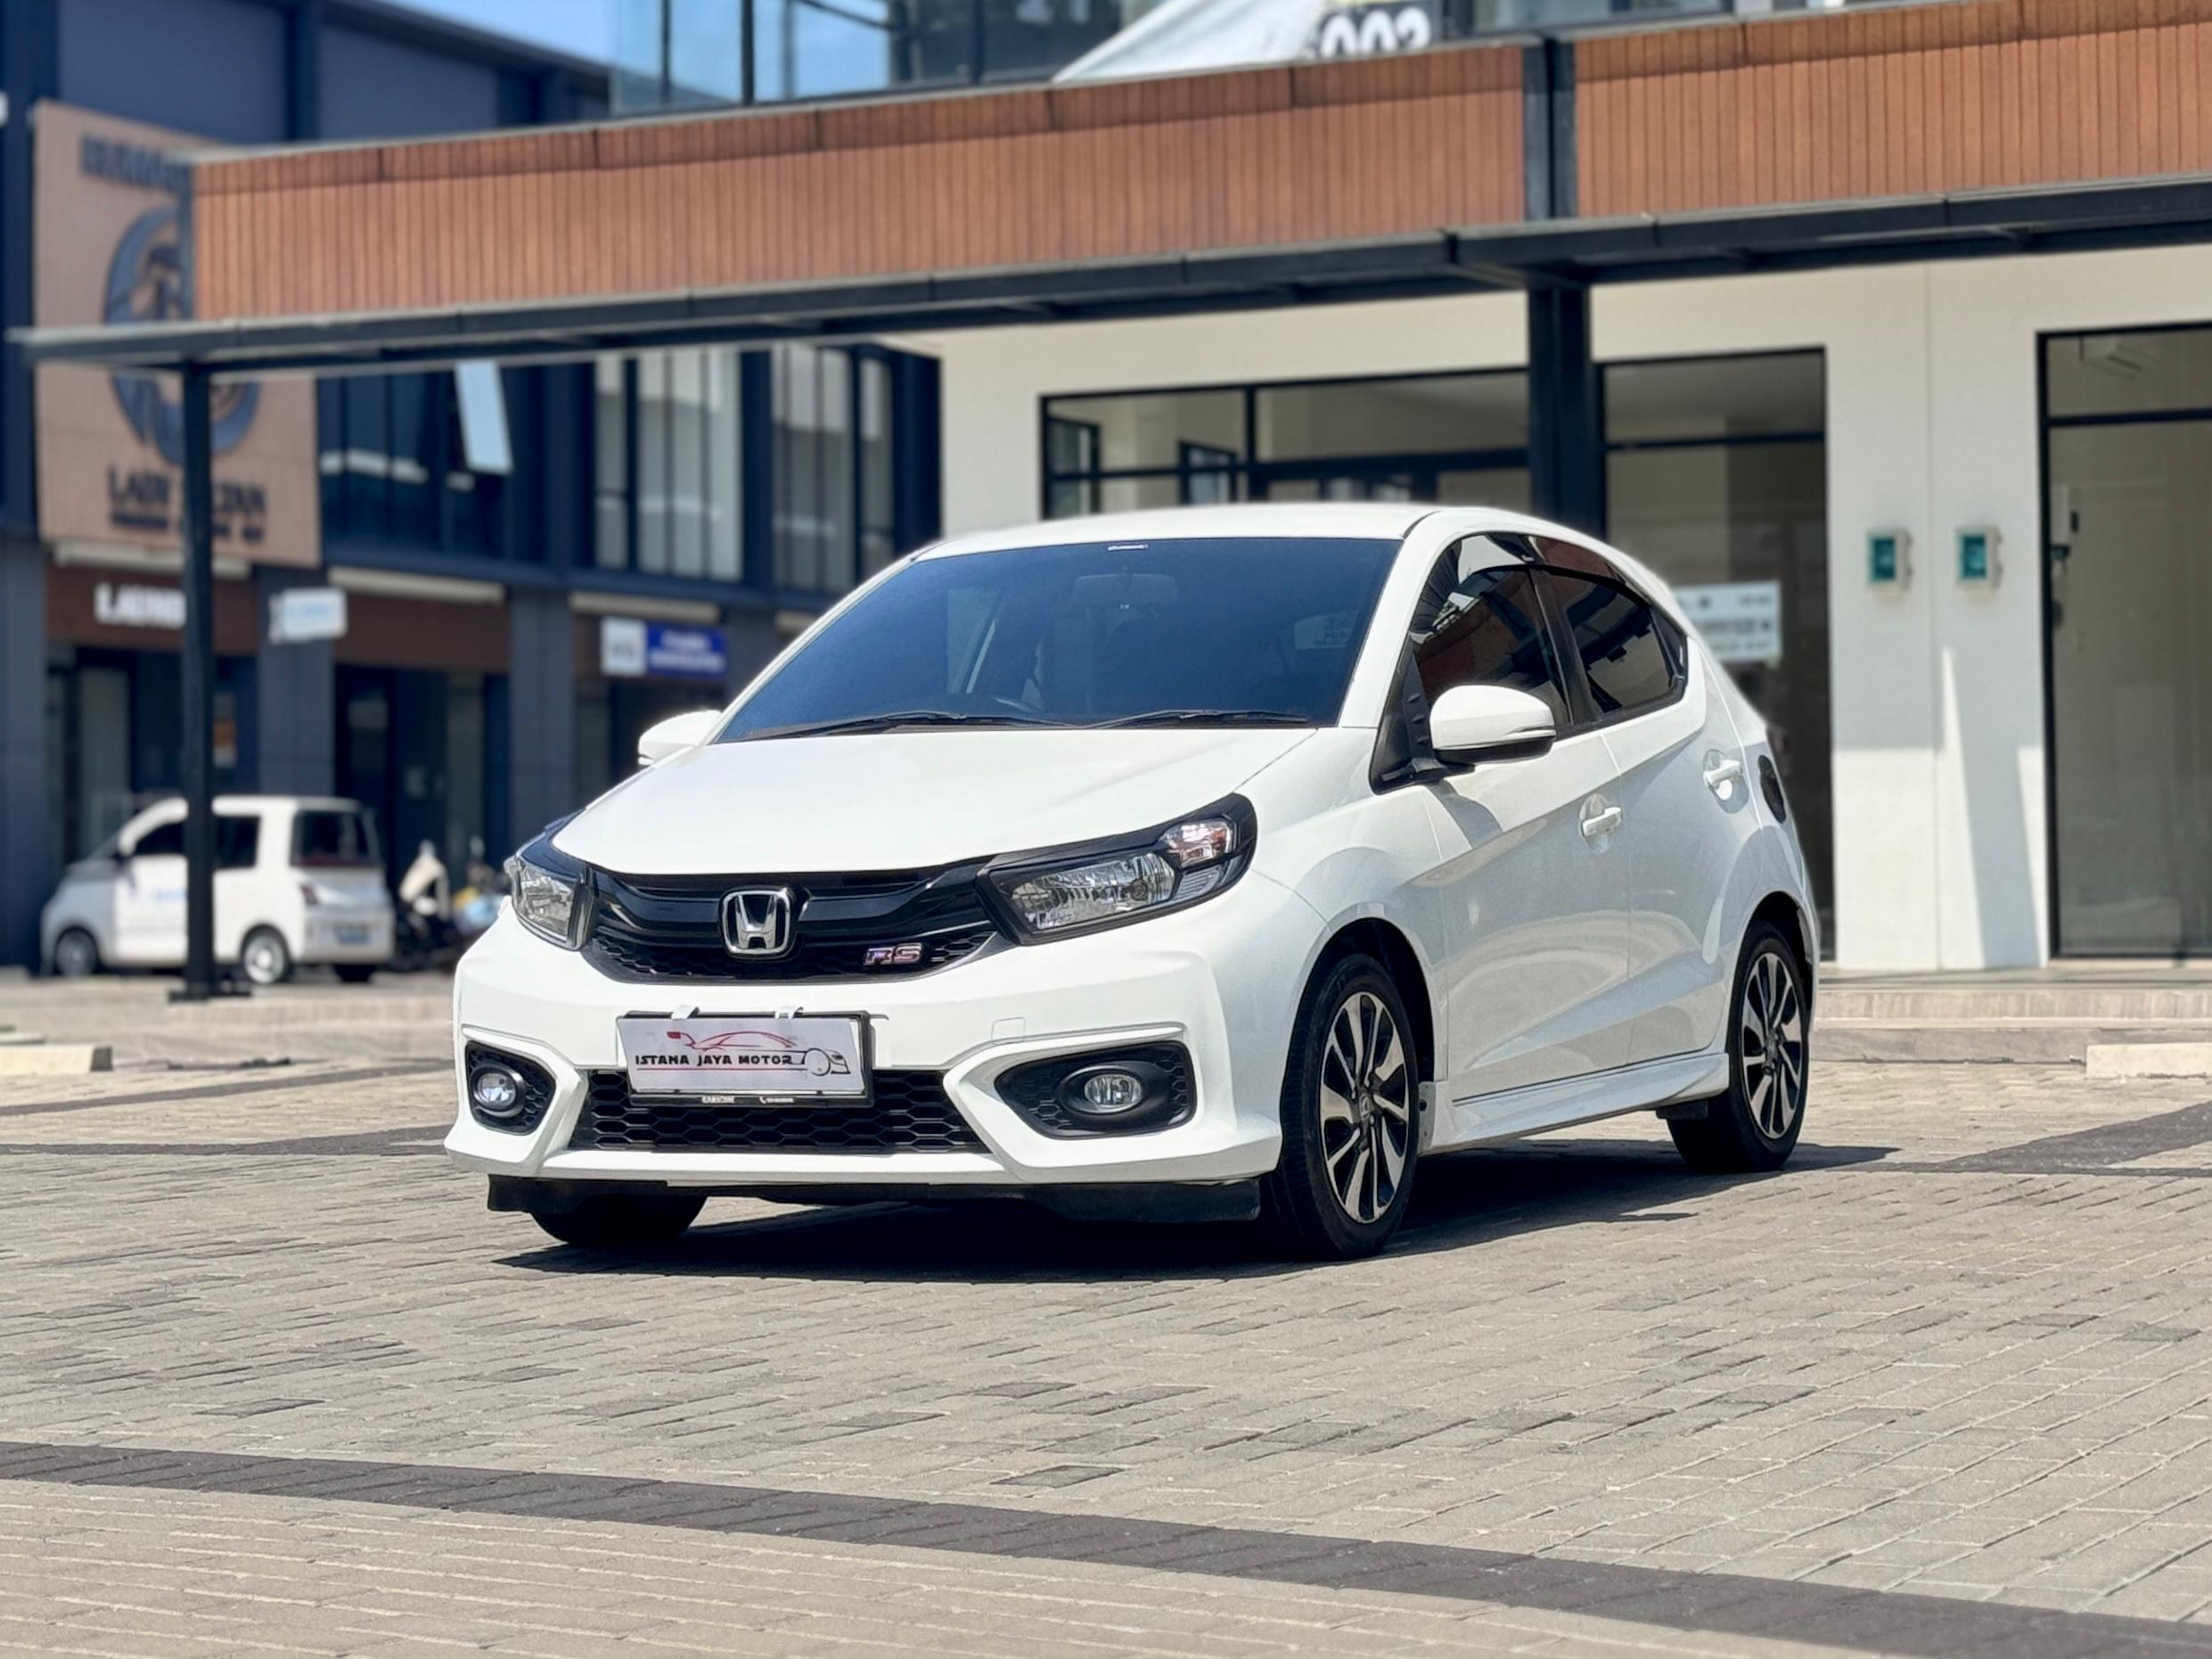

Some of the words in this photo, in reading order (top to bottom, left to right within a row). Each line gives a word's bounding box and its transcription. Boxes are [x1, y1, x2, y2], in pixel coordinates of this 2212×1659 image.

[863, 942, 922, 965] RS
[635, 1055, 691, 1065] ISTANA
[697, 1055, 733, 1067] JAYA
[738, 1054, 793, 1065] MOTOR
